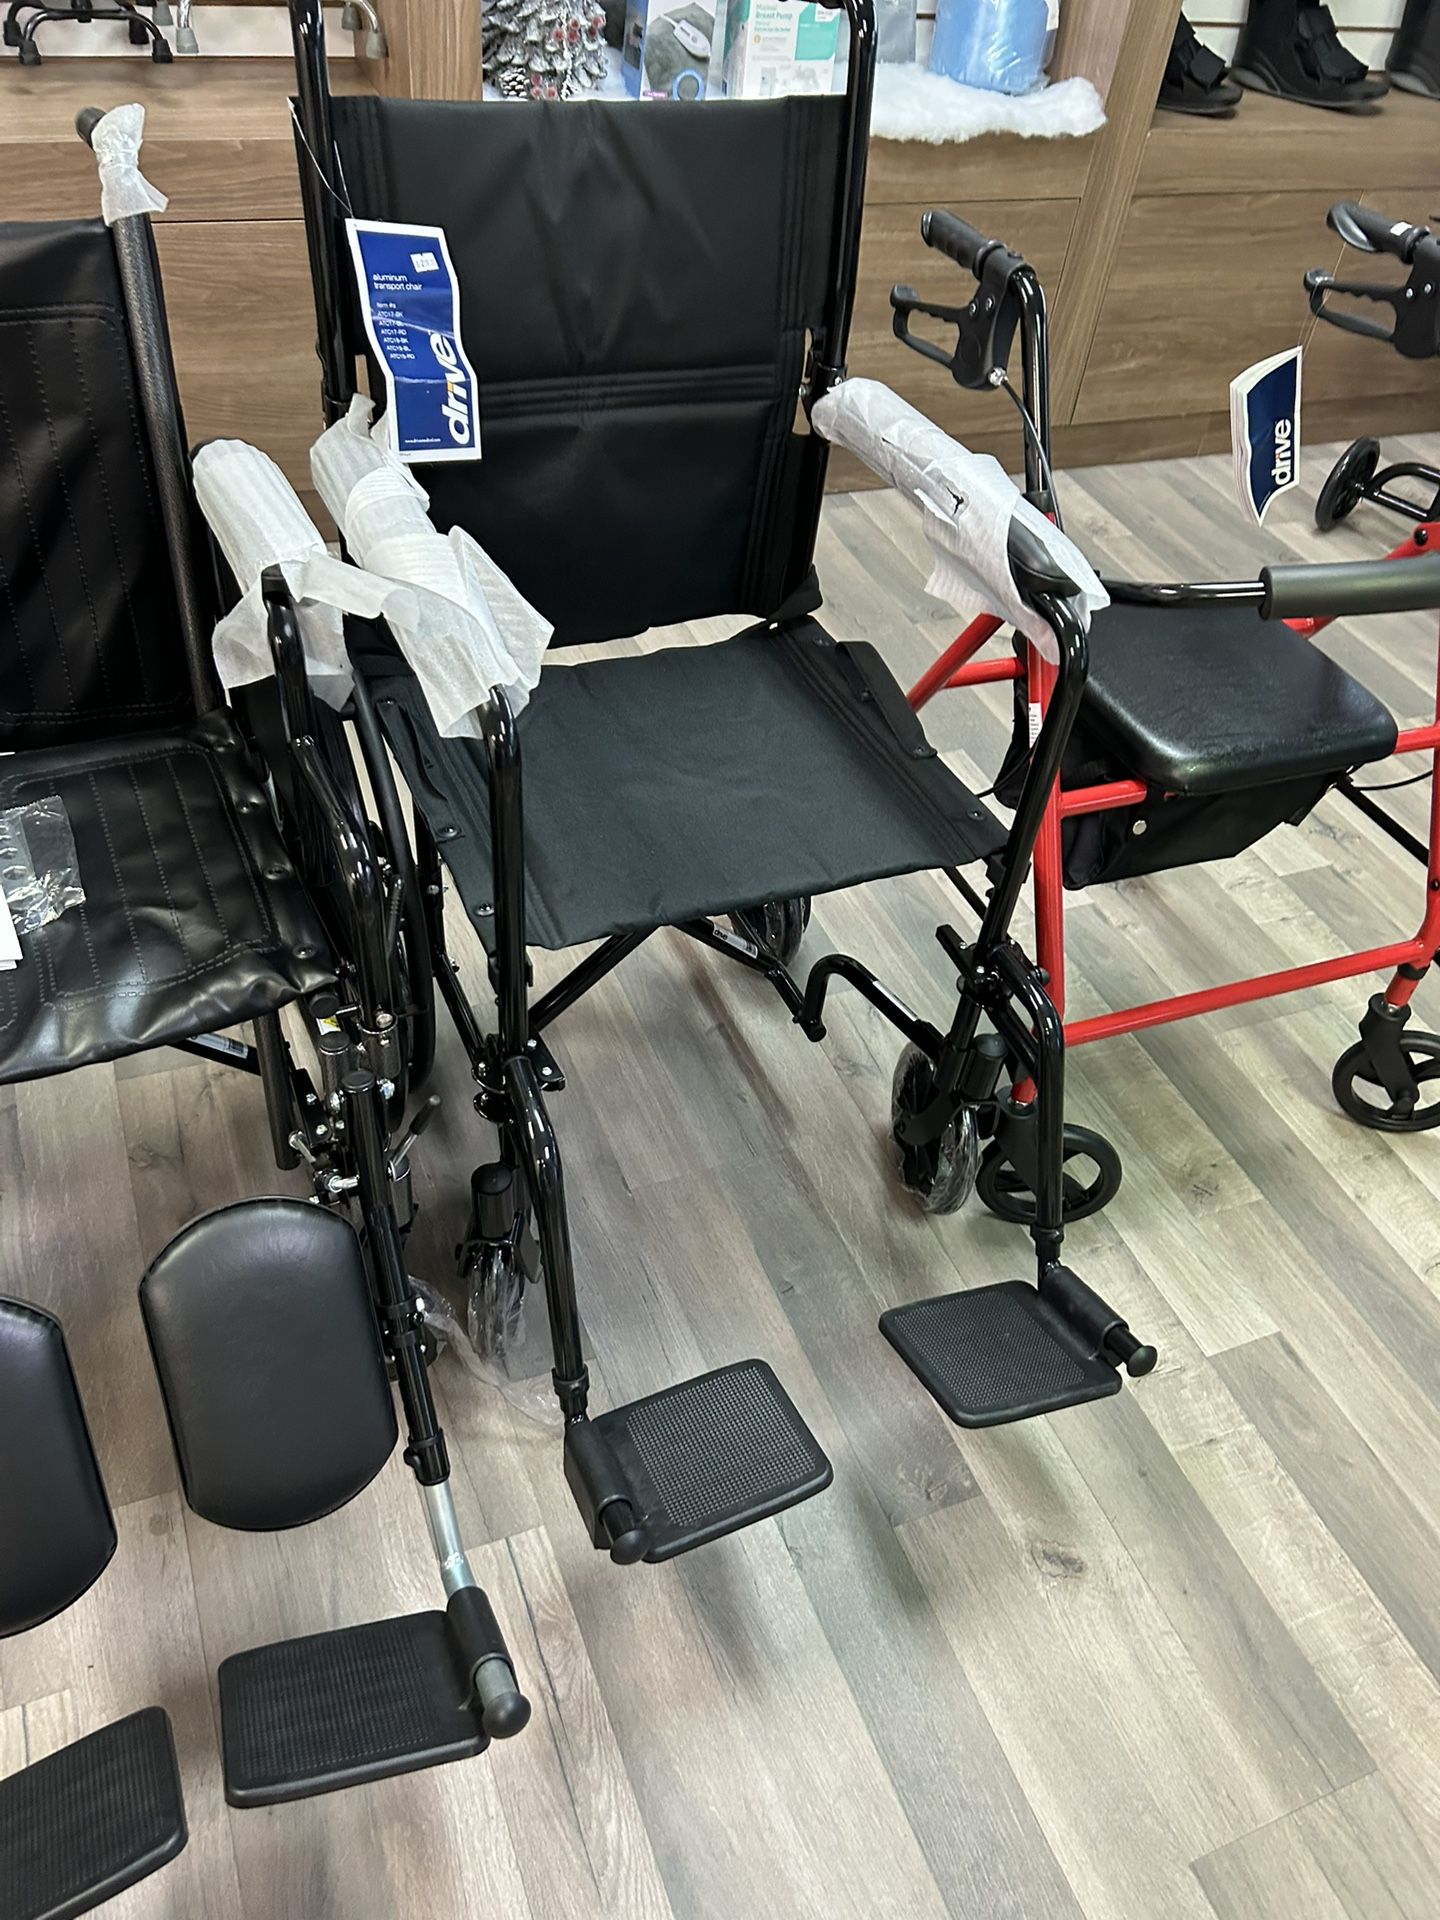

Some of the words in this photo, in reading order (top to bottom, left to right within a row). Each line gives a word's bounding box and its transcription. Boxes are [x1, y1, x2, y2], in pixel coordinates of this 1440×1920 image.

[373, 273, 408, 282] aluminum
[374, 281, 405, 291] transport
[405, 282, 423, 290] chair
[429, 331, 470, 445] drive
[1271, 418, 1291, 486] drive
[714, 929, 728, 941] drive
